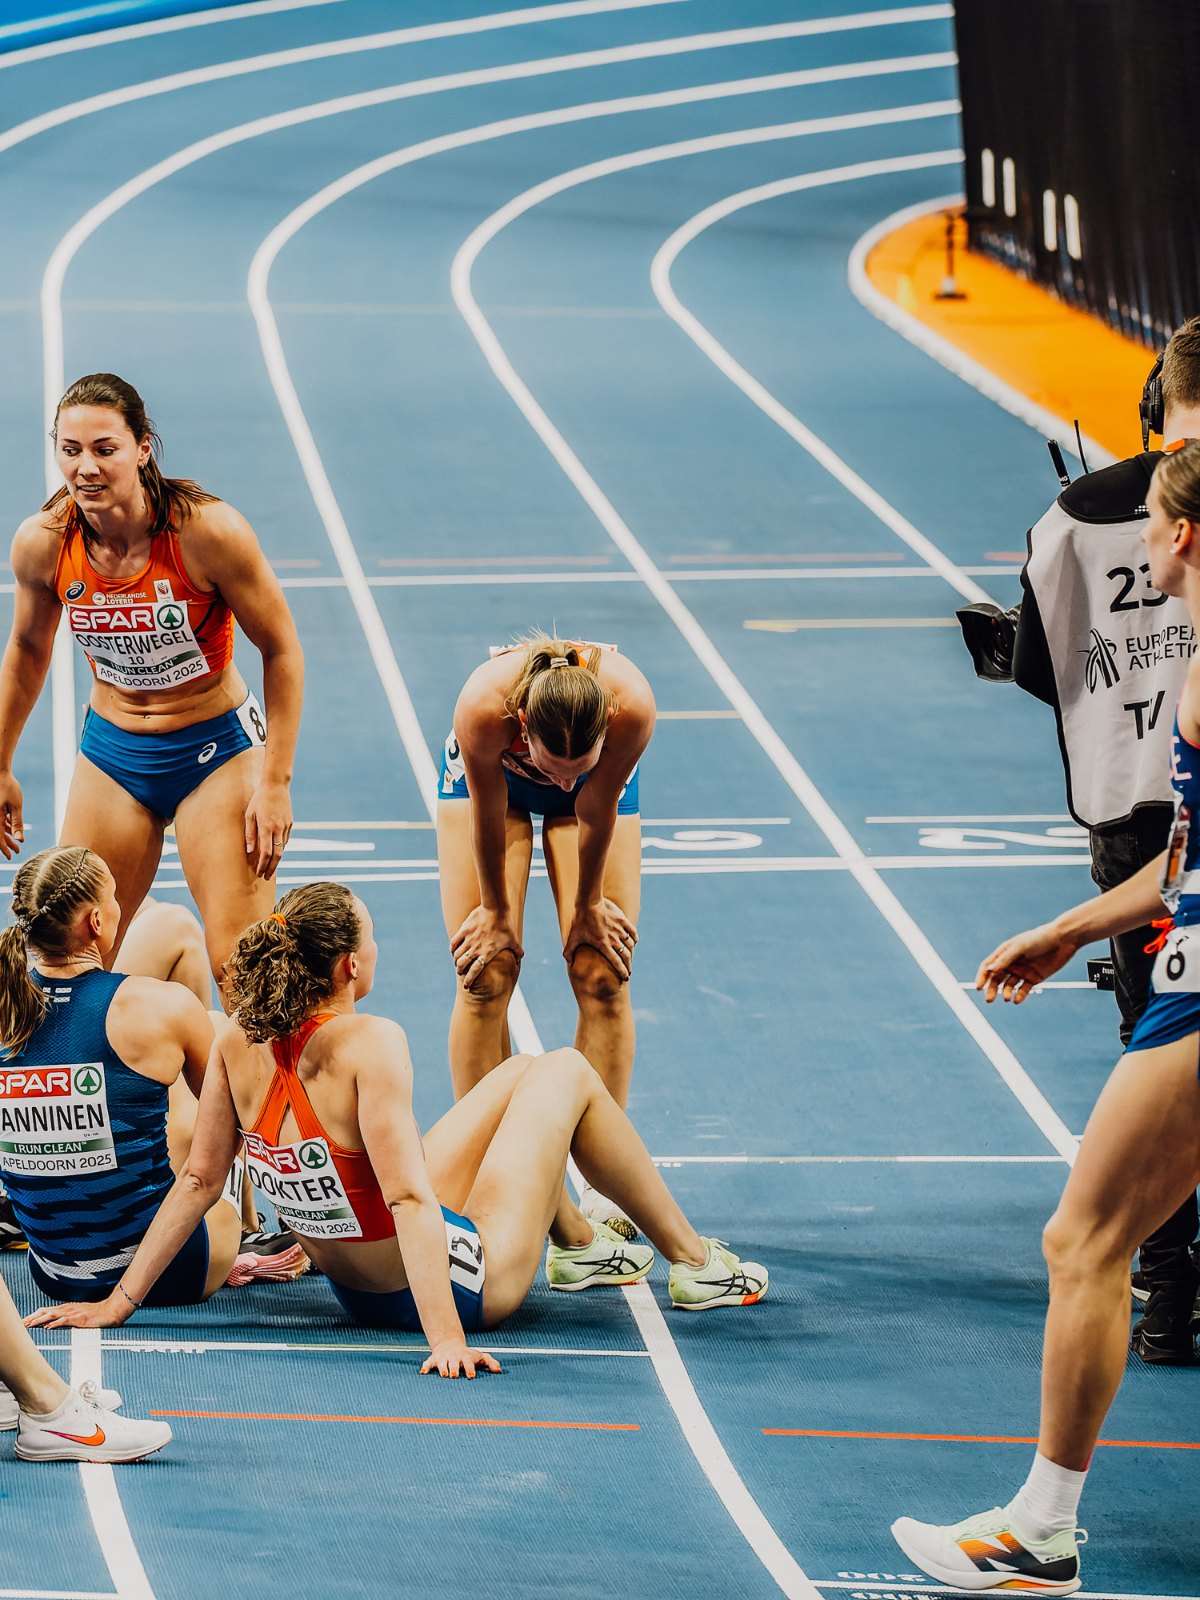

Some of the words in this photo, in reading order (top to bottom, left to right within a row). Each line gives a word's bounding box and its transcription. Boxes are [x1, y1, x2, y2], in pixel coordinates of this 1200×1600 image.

[71, 609, 153, 630] SPAR
[75, 630, 193, 655] OOSTERWEGEL
[128, 656, 145, 665] 10
[100, 667, 171, 687] APELDOORN
[173, 660, 203, 680] 2025
[249, 706, 267, 742] 8
[1124, 690, 1166, 740] TV
[13, 1144, 18, 1153] I
[19, 1144, 41, 1153] RUN
[3, 1157, 77, 1171] APELDOORN
[79, 1153, 112, 1169] 2025
[248, 1164, 343, 1202] DOKTER
[327, 1222, 357, 1234] 2025
